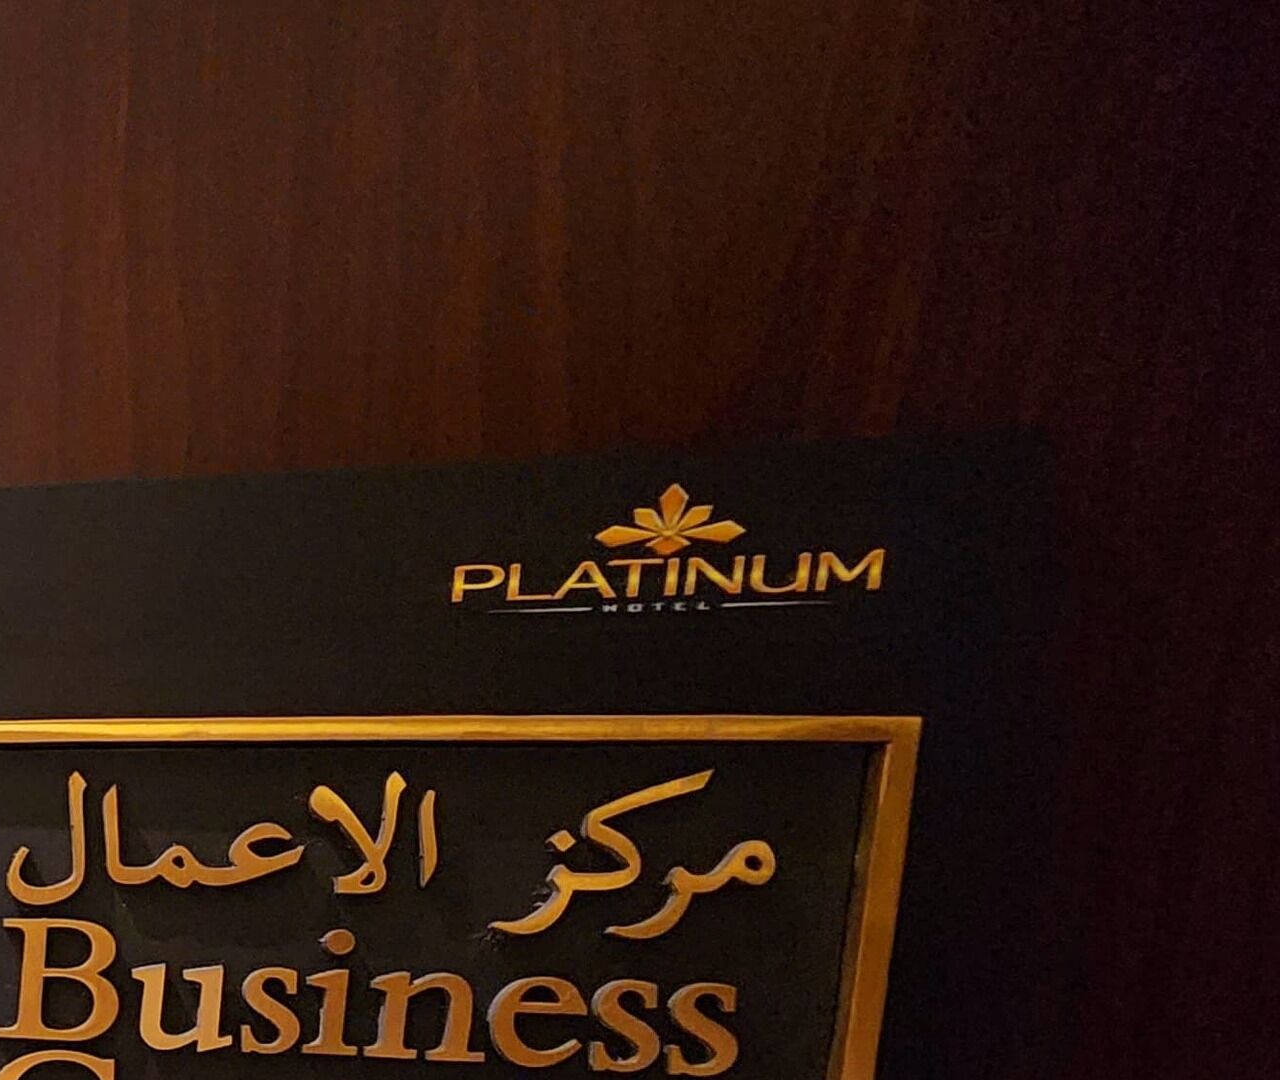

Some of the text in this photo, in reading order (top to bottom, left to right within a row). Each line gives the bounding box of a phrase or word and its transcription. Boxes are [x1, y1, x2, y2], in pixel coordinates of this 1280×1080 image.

[451, 549, 886, 602] PLATINUM
[602, 601, 711, 612] HOTEL
[6, 769, 778, 939] مركز الاعمال
